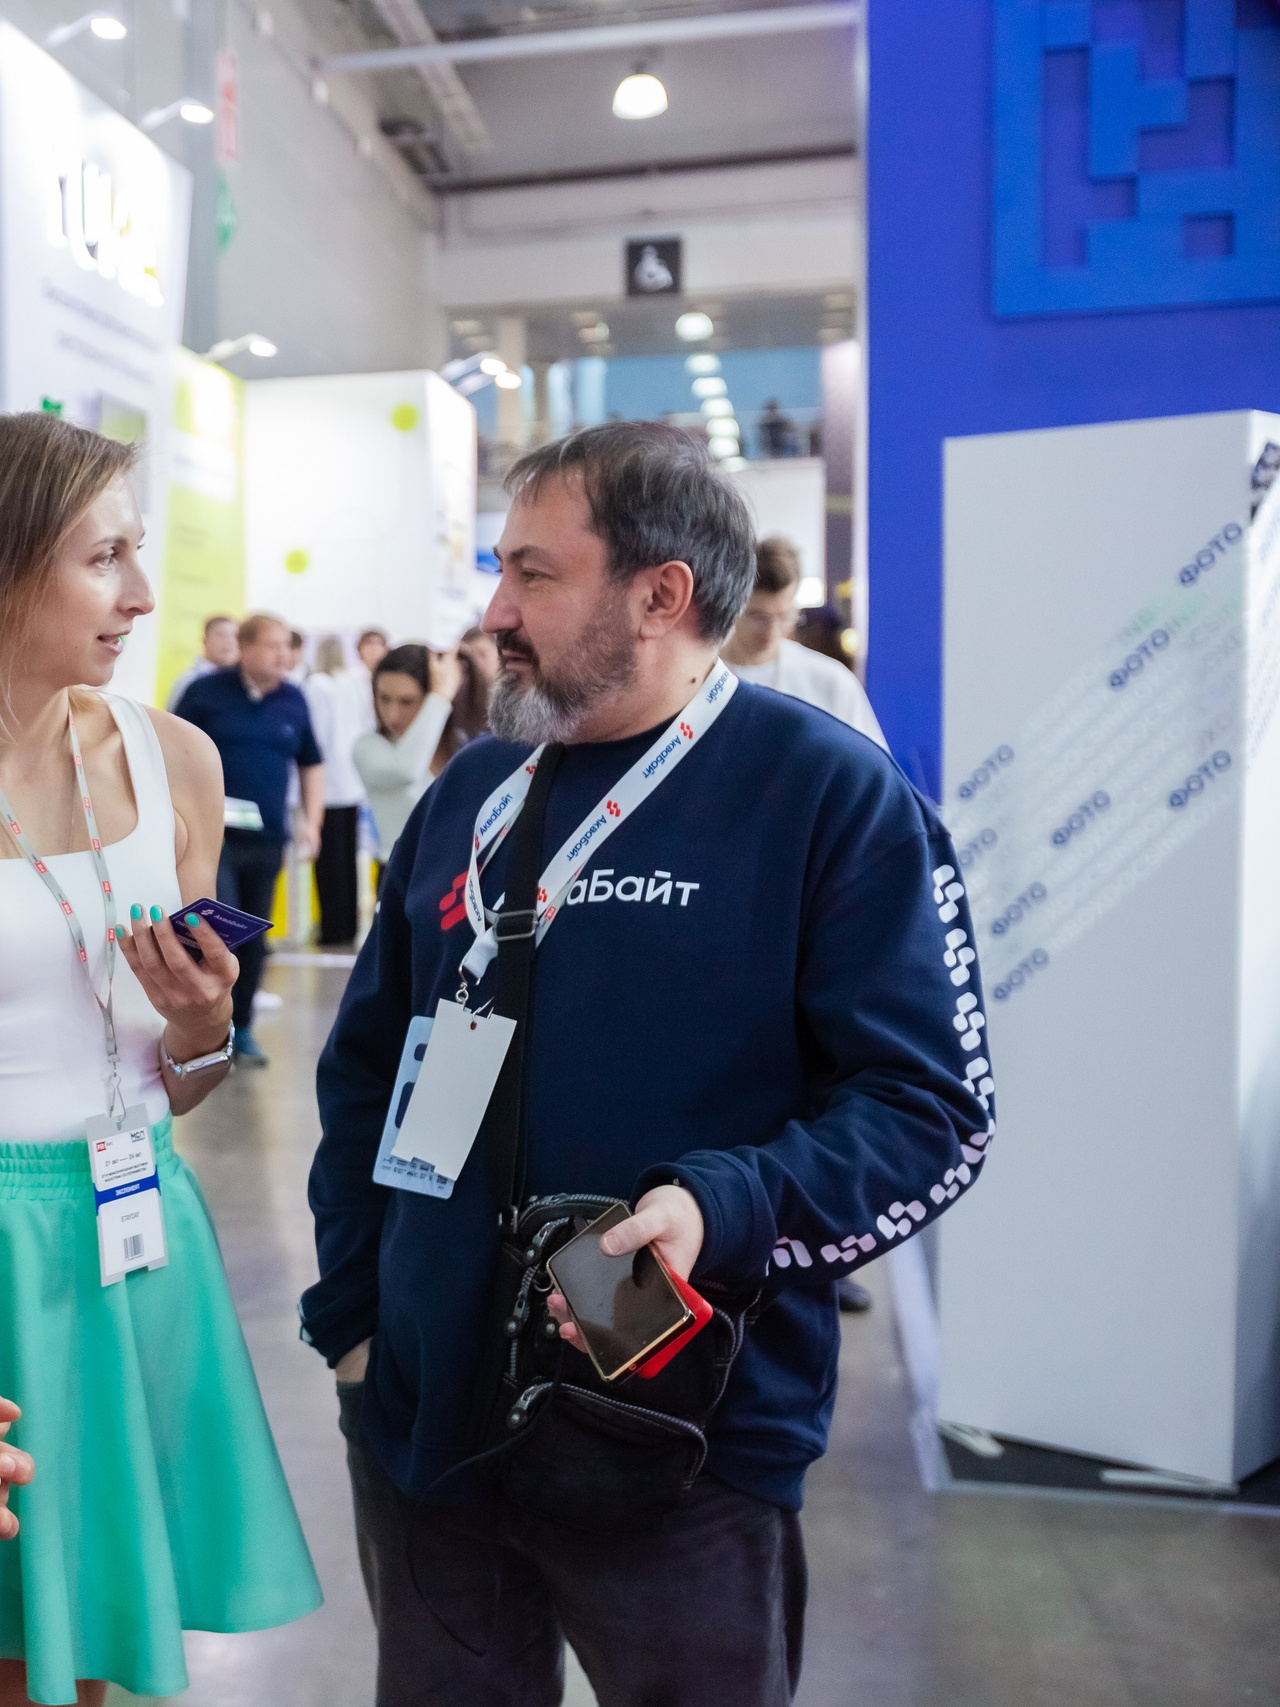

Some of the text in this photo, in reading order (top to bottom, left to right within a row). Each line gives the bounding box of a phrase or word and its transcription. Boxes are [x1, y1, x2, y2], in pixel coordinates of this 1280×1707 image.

[1180, 523, 1242, 586] ФОТО
[1109, 629, 1169, 689] ФОТО
[642, 735, 682, 779] АкваБайт
[959, 745, 1014, 798] ФОТО
[1169, 750, 1231, 809] ФОТО
[479, 793, 514, 836] АкваБайт
[566, 814, 608, 861] АкваБайт
[1052, 790, 1110, 846] ФОТО
[959, 828, 997, 868] ОТО
[991, 883, 1047, 935] ФОТО
[992, 949, 1048, 1001] ФОТО
